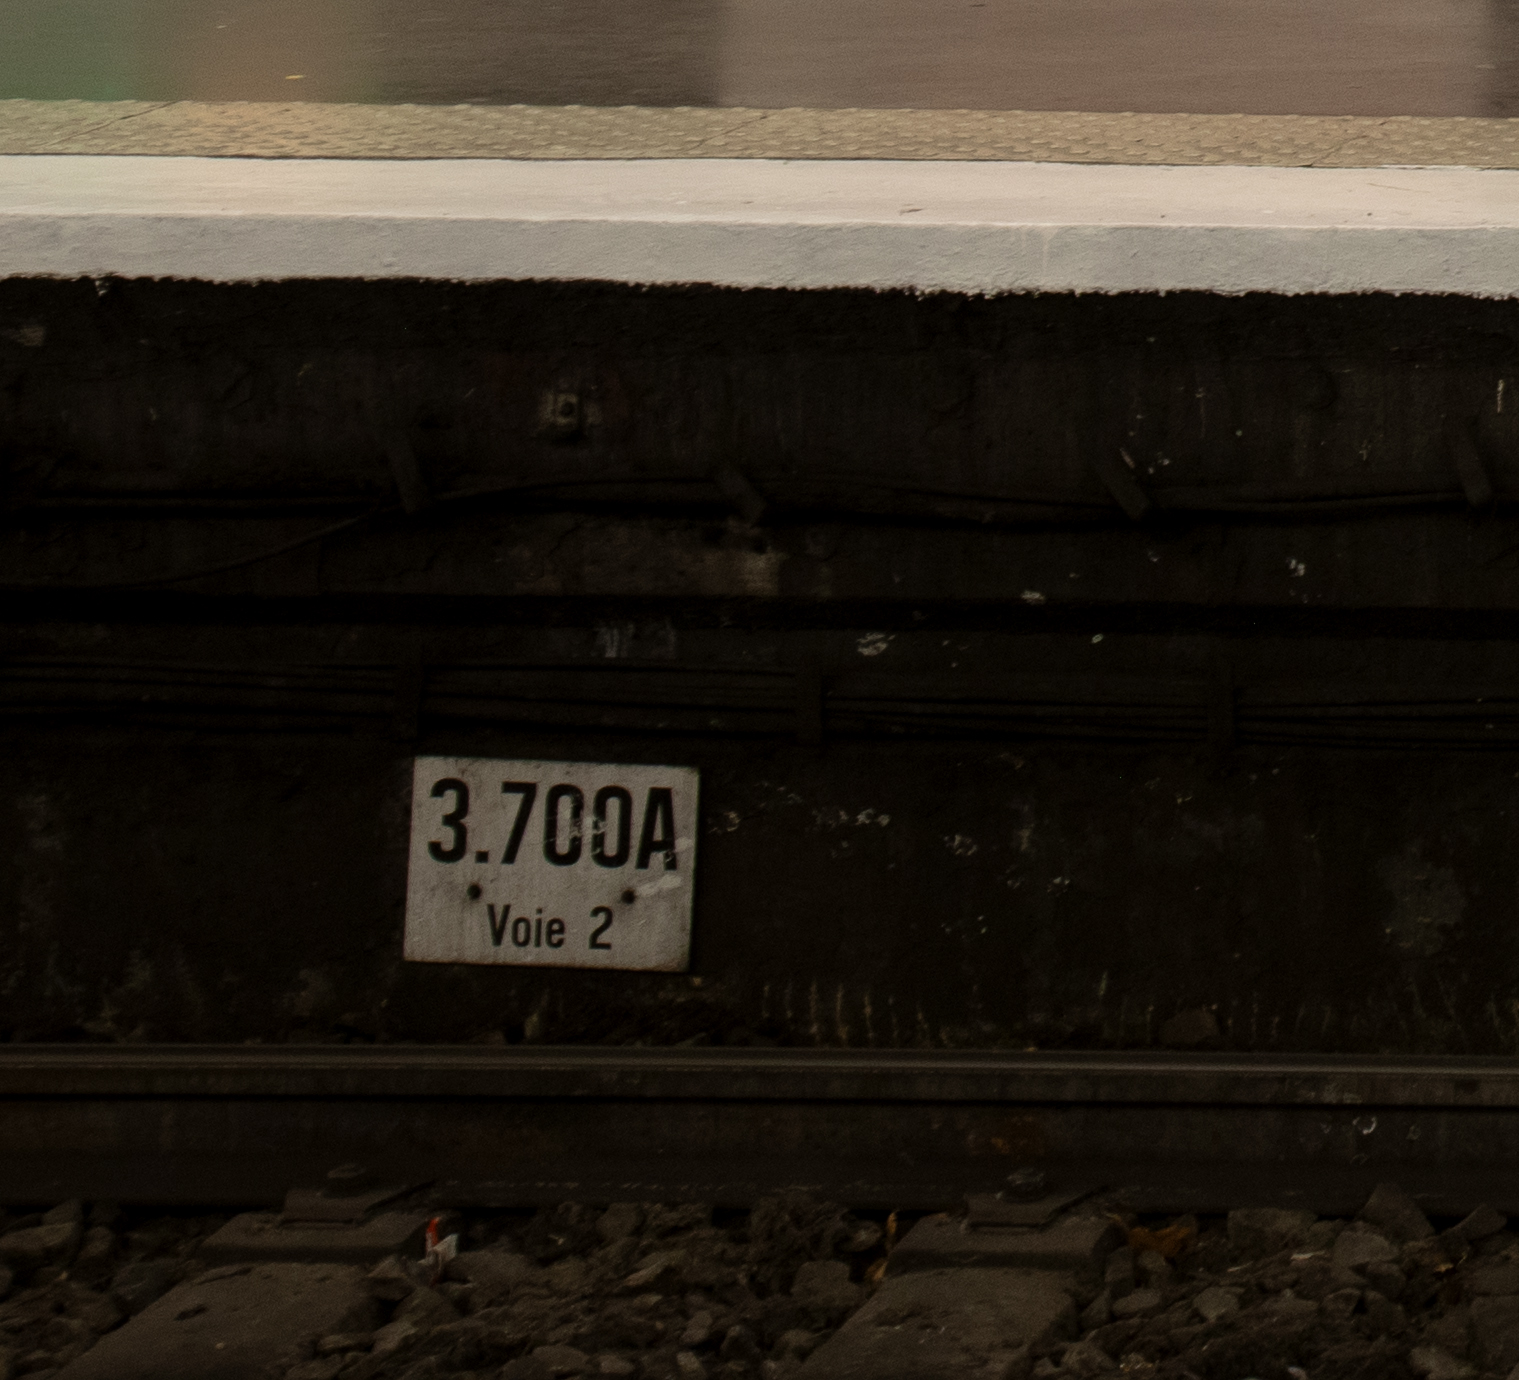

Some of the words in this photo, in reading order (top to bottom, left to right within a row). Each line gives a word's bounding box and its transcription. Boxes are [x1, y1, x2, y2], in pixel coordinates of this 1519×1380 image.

[427, 777, 678, 871] 3.700A
[487, 903, 566, 949] Voie
[588, 905, 614, 950] 2
